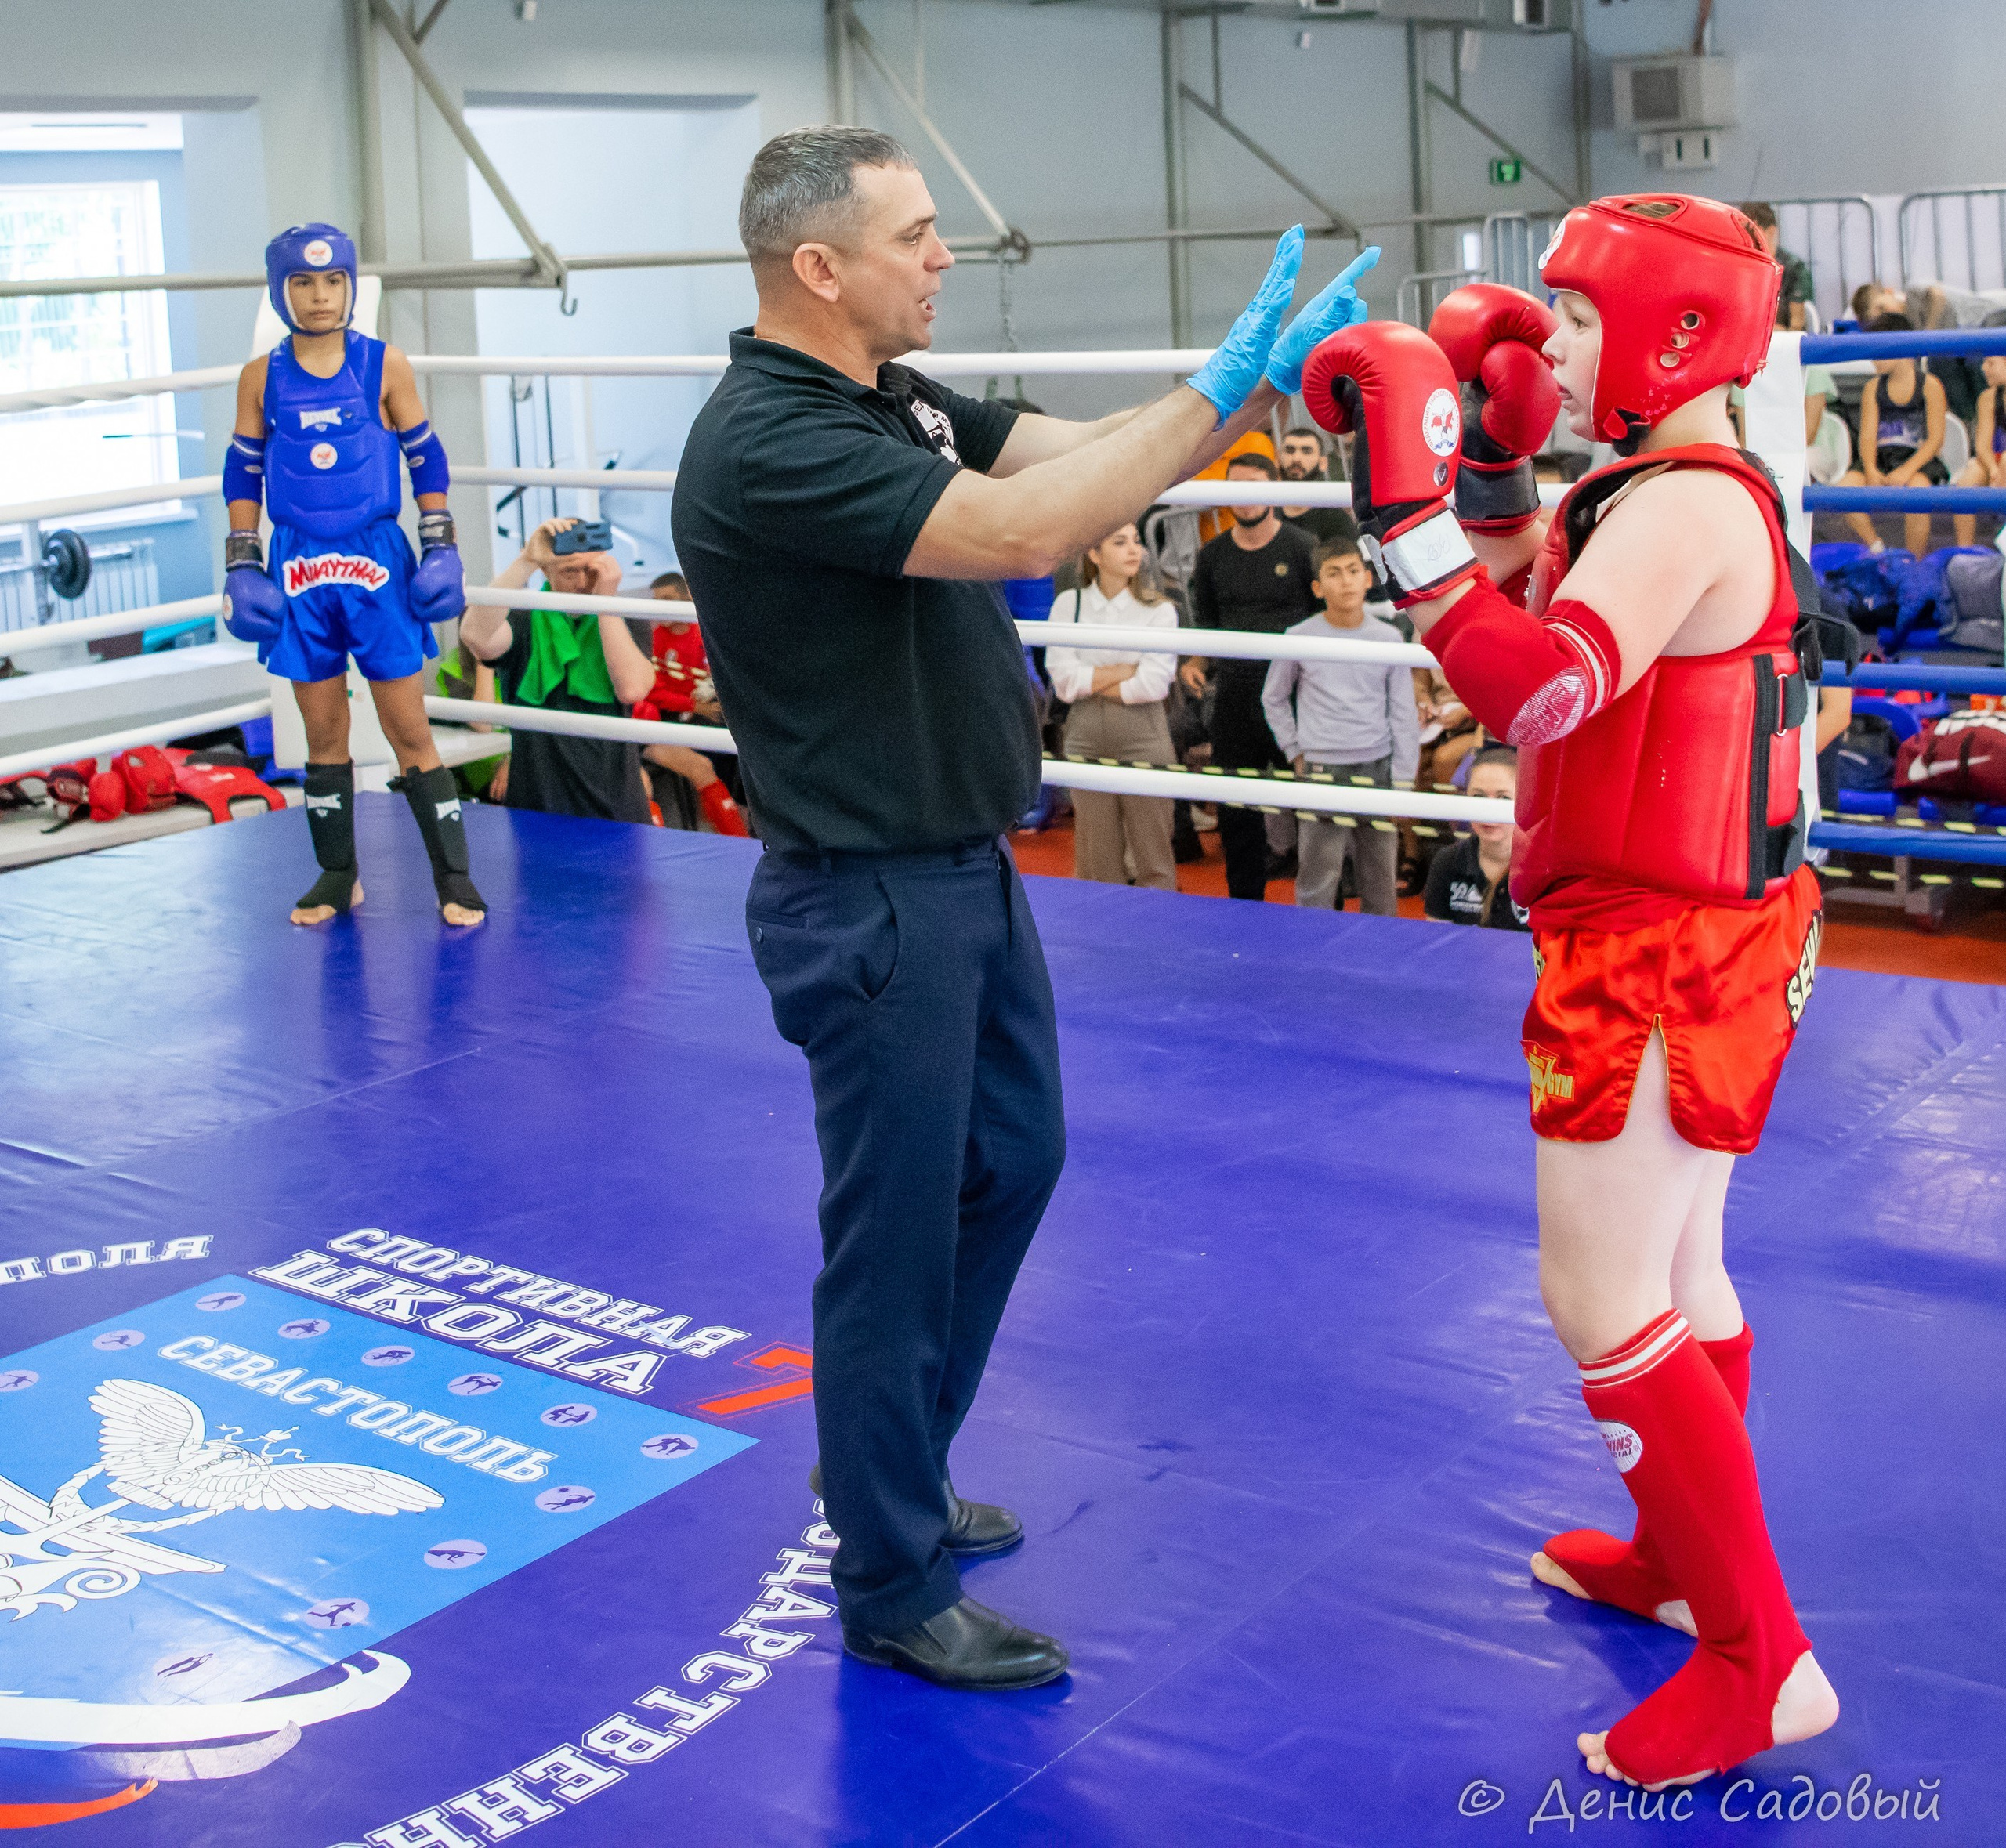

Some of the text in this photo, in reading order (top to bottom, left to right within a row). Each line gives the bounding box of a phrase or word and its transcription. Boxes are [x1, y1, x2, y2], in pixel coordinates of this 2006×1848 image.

[288, 559, 387, 590] MUAYTHAI
[248, 1249, 667, 1395] ШКОЛА
[326, 1227, 752, 1358] СПОРТИВНАЯ
[158, 1335, 559, 1482] СЕВАСТОПОЛЬ
